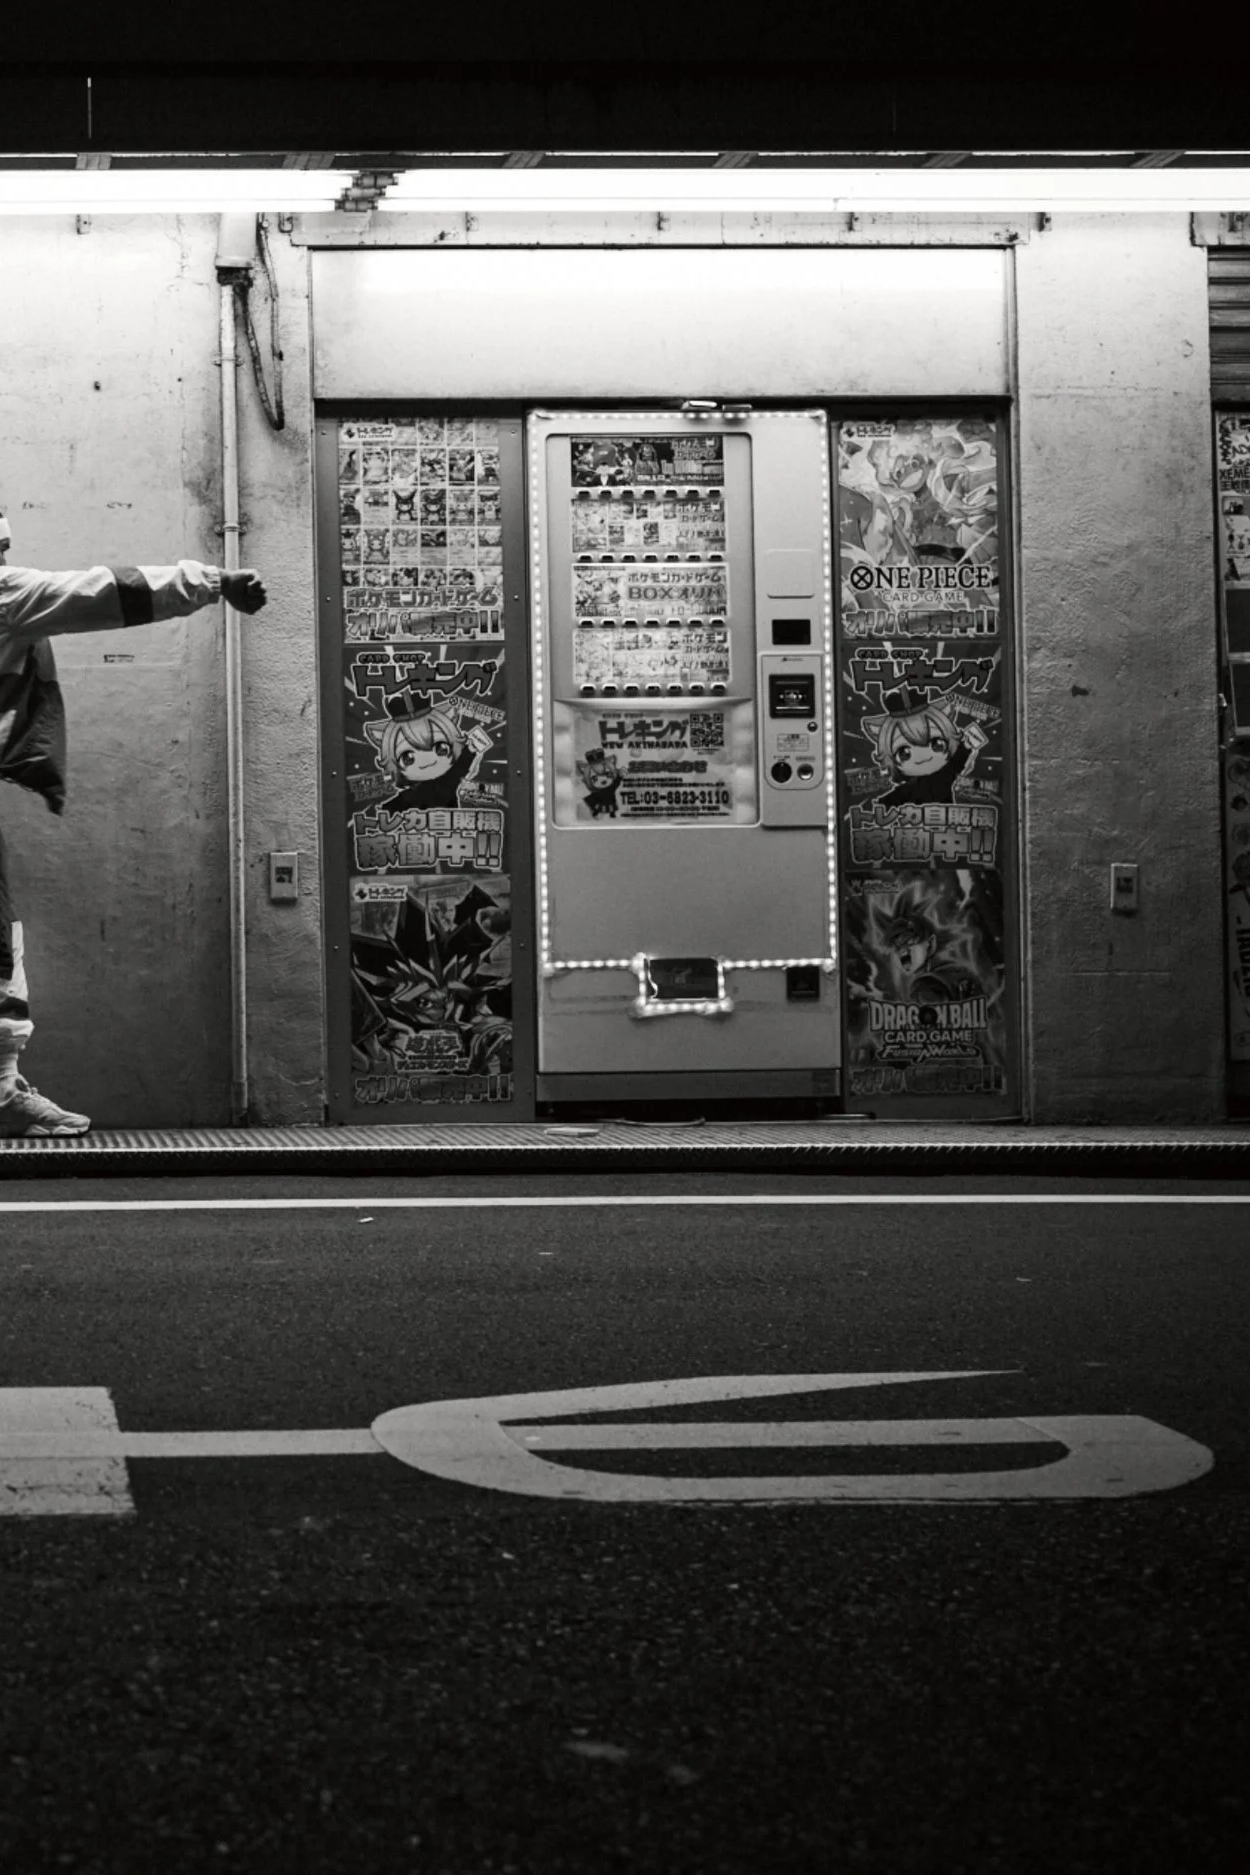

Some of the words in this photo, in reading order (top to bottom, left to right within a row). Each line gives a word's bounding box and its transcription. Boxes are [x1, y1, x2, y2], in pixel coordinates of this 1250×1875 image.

[850, 565, 912, 591] ONE
[918, 566, 991, 590] PIECE
[882, 591, 920, 602] CARD
[924, 591, 965, 602] GAME
[869, 1000, 947, 1031] DRAGON
[950, 997, 988, 1029] BALL
[885, 1031, 927, 1043] CARD
[930, 1031, 973, 1042] GAME
